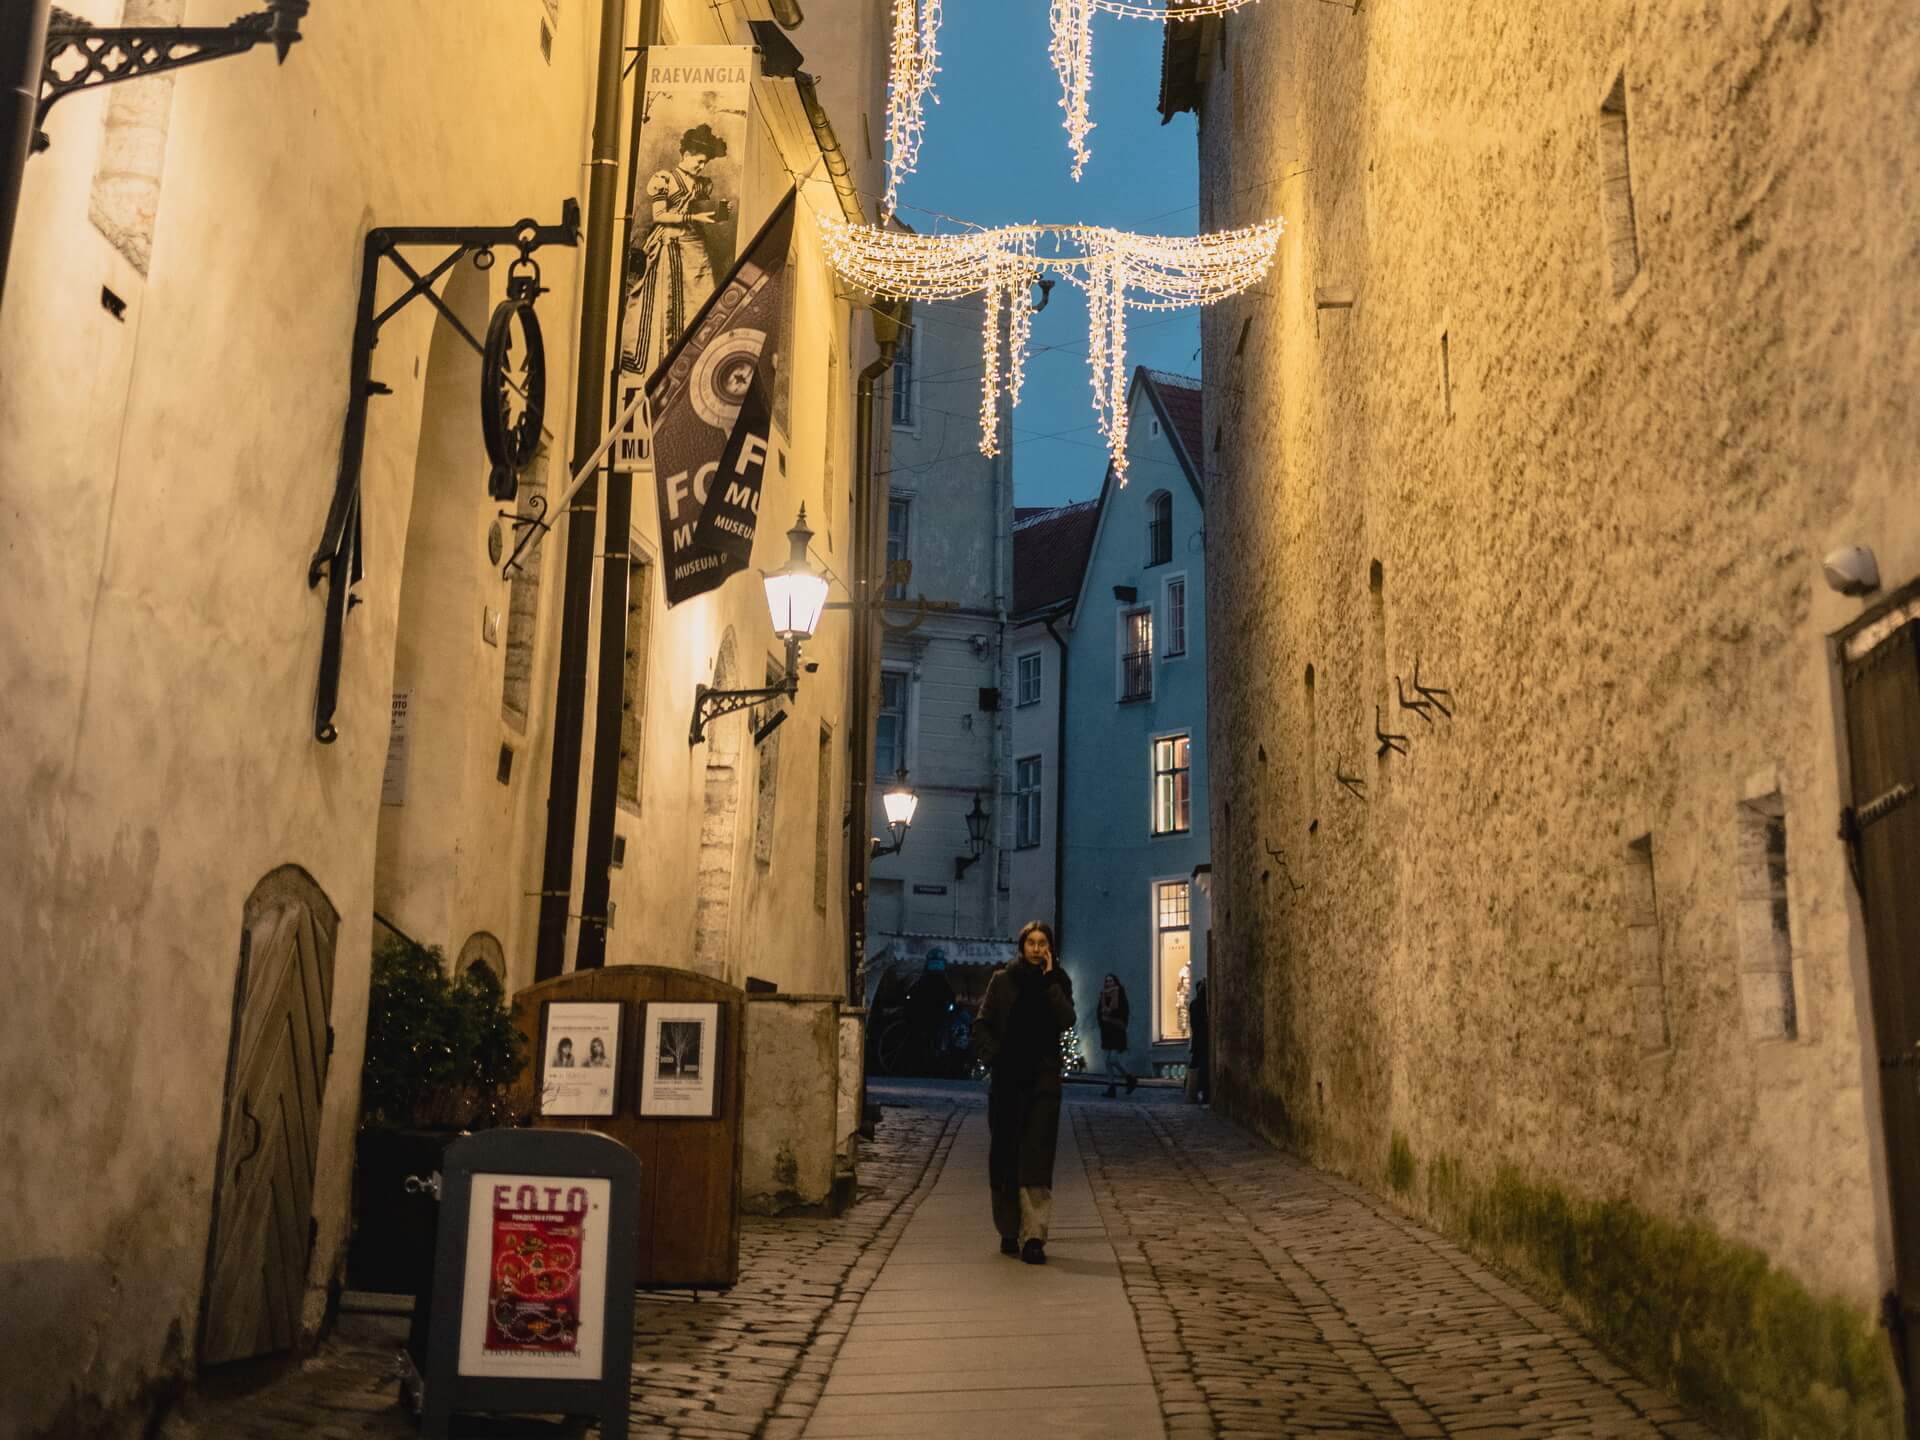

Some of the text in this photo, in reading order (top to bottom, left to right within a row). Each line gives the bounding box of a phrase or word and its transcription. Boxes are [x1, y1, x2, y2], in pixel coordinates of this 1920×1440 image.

[651, 67, 745, 84] RAEVANGLA
[622, 439, 650, 460] MU
[735, 432, 768, 475] F
[673, 520, 698, 553] M
[675, 554, 719, 581] MUSEUM
